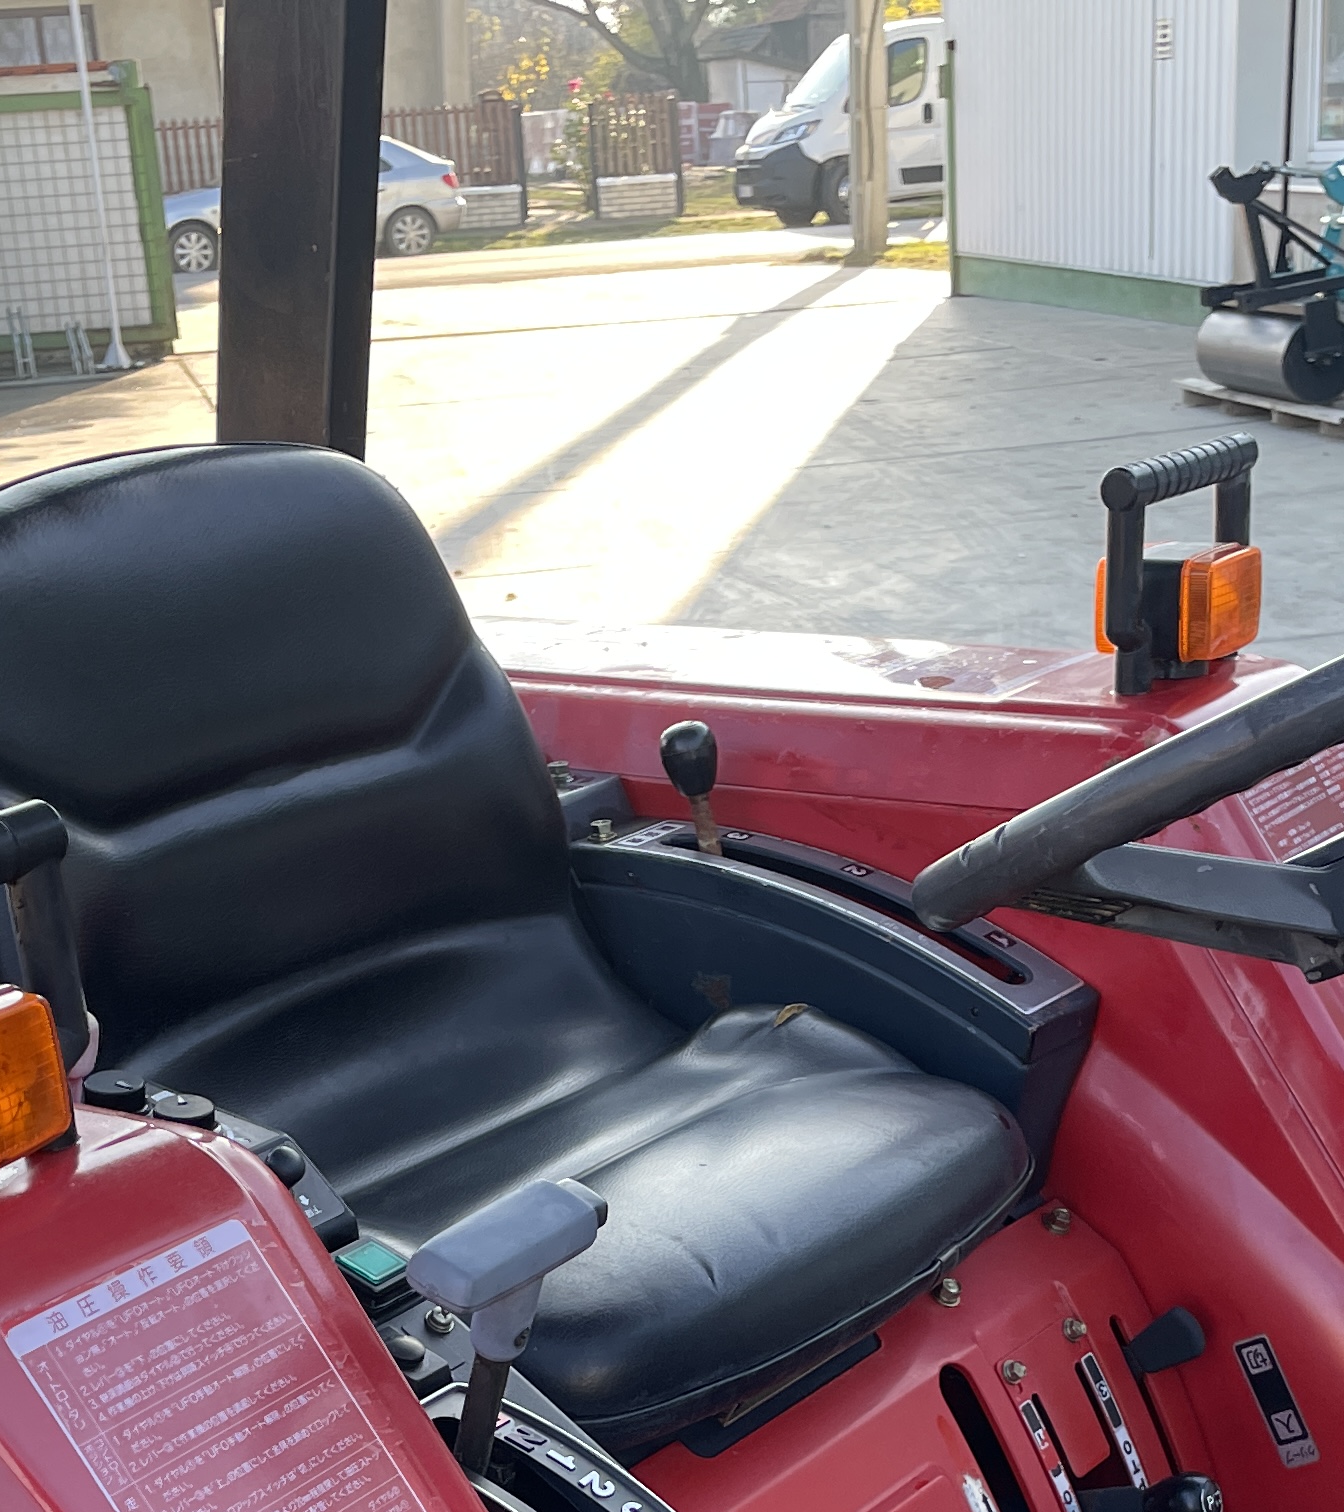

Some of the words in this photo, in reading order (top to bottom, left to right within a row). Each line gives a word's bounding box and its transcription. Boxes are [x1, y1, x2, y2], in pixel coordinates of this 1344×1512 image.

[1246, 1350, 1268, 1370] 切
[1274, 1413, 1295, 1433] 入
[546, 1449, 576, 1471] 1
[578, 1470, 616, 1498] 2
